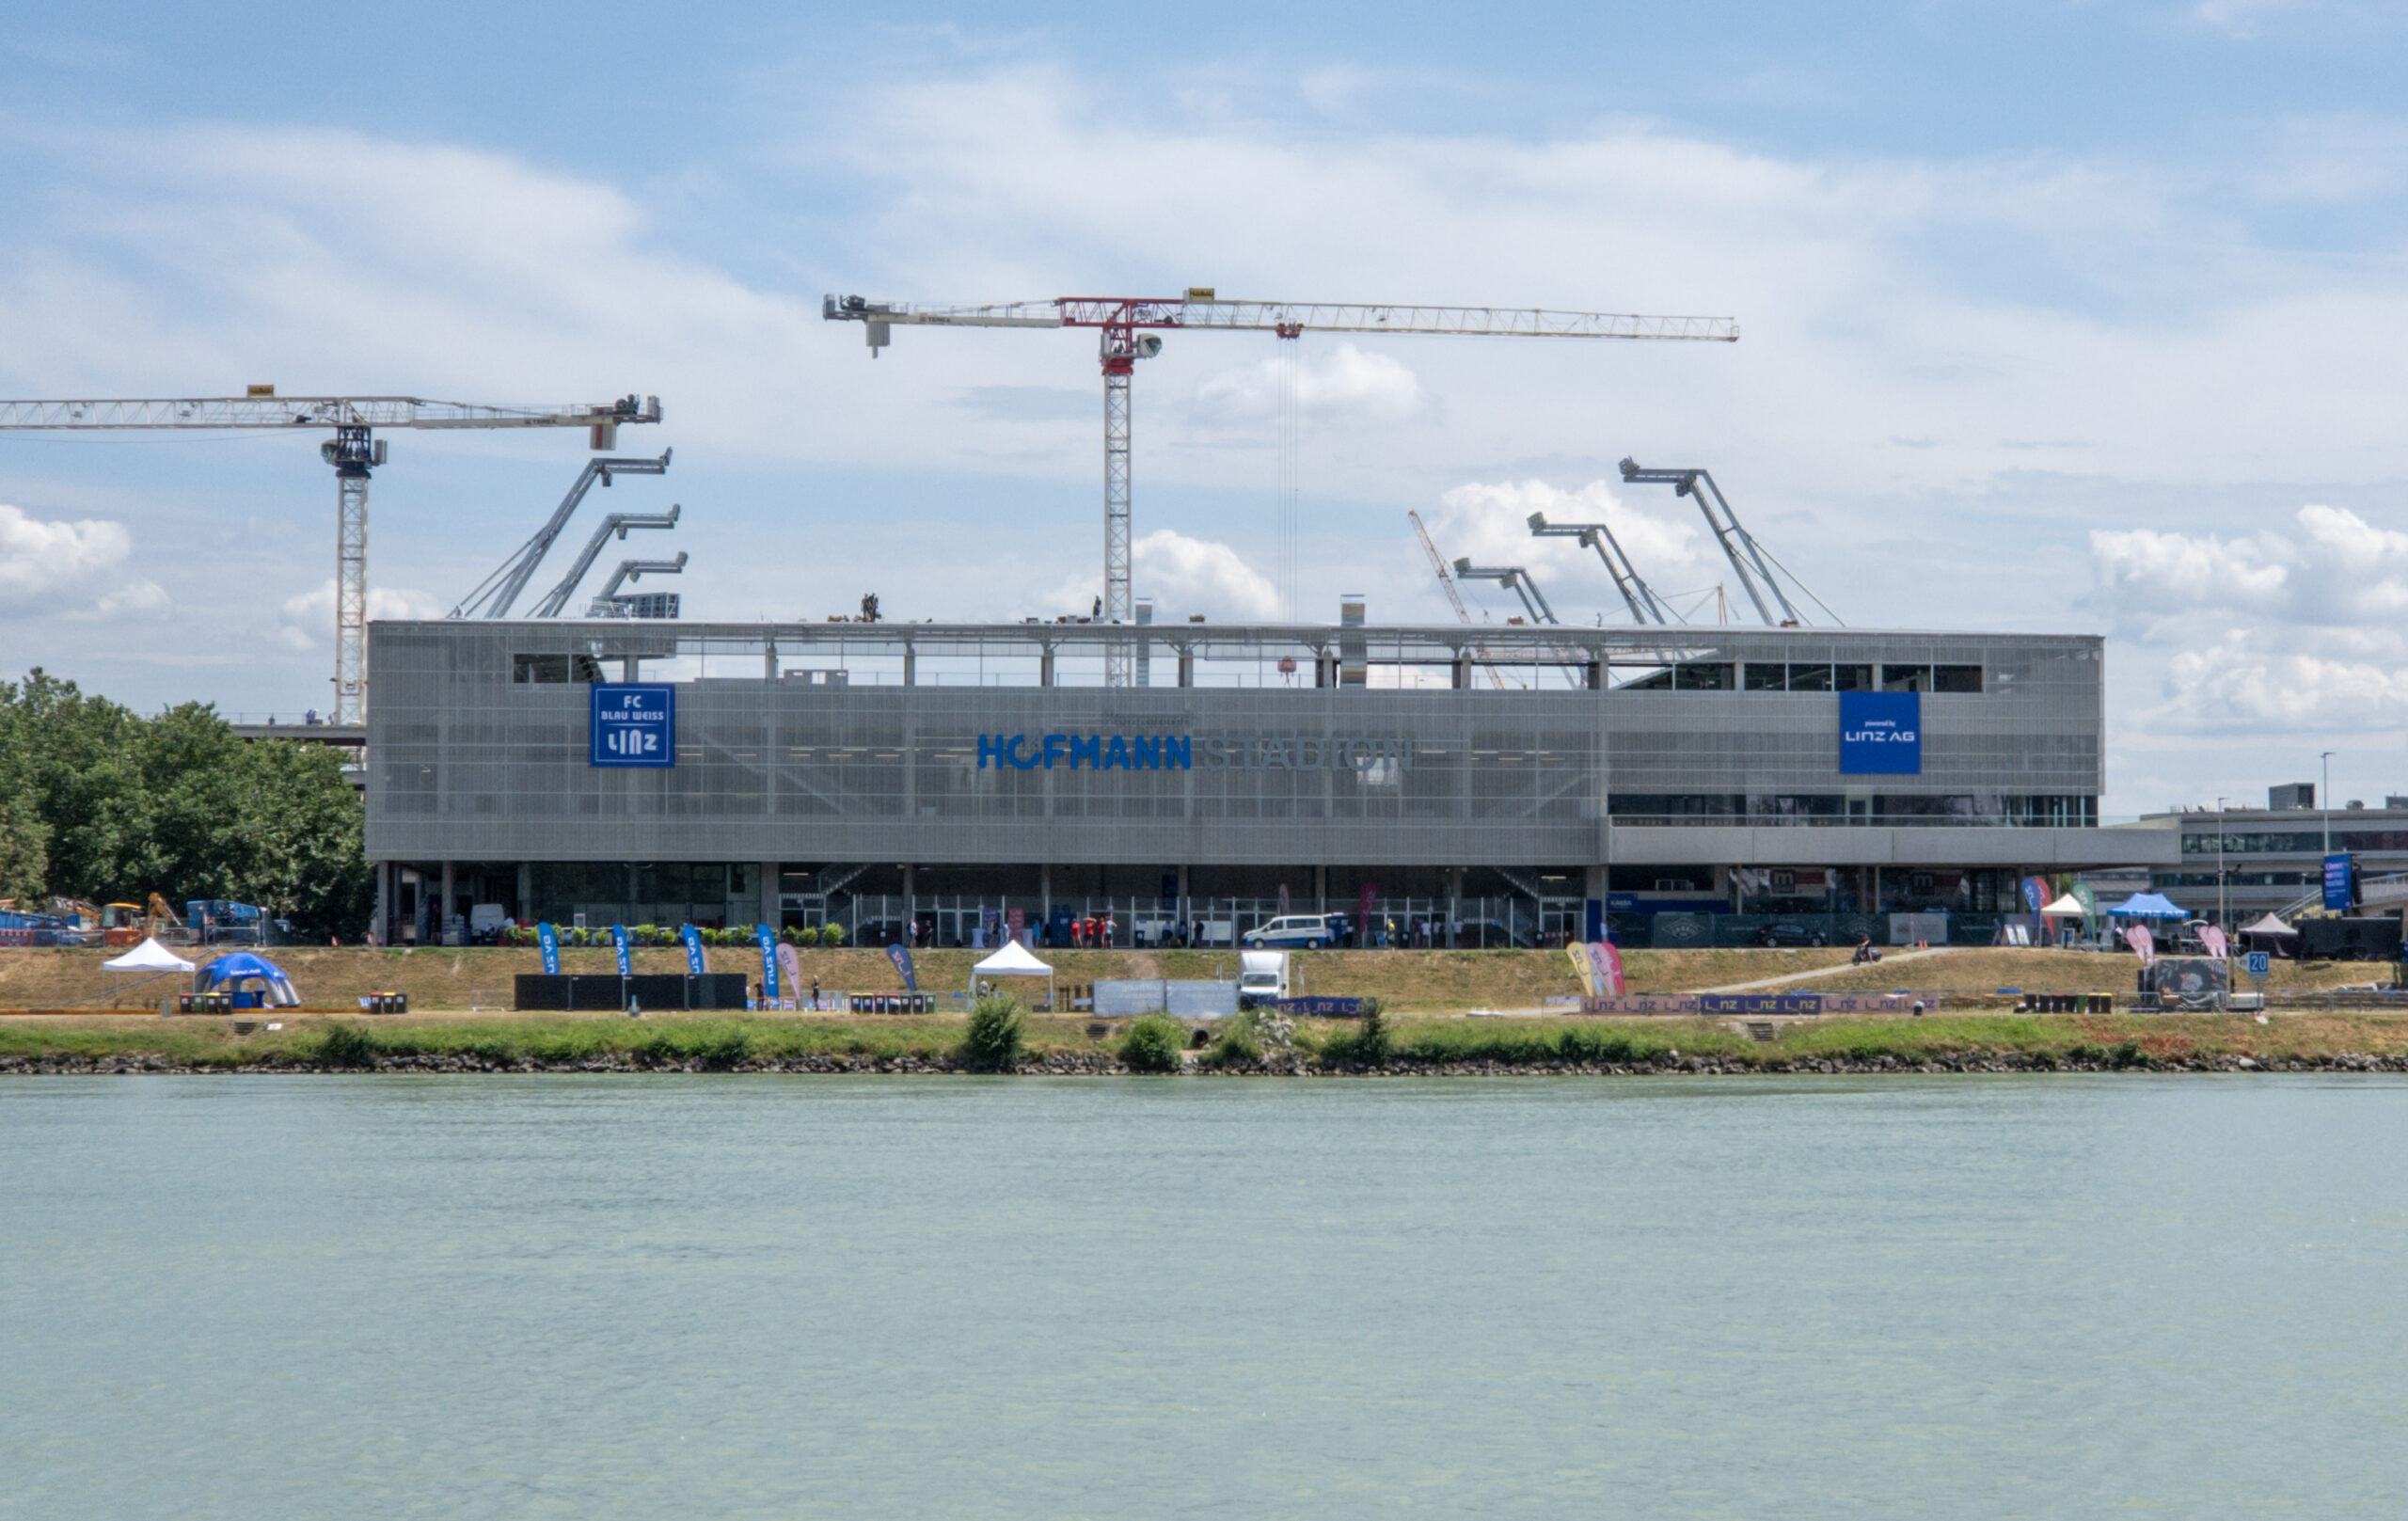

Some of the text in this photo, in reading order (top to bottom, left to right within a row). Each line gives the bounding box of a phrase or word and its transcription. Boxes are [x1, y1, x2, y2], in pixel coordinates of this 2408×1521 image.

[624, 695, 642, 708] FC
[601, 711, 664, 721] BLAU WEISS
[608, 729, 657, 754] LINZ
[1845, 731, 1915, 742] LINZ AG
[977, 734, 1413, 771] HOFMANN STADION
[2251, 955, 2267, 971] 20
